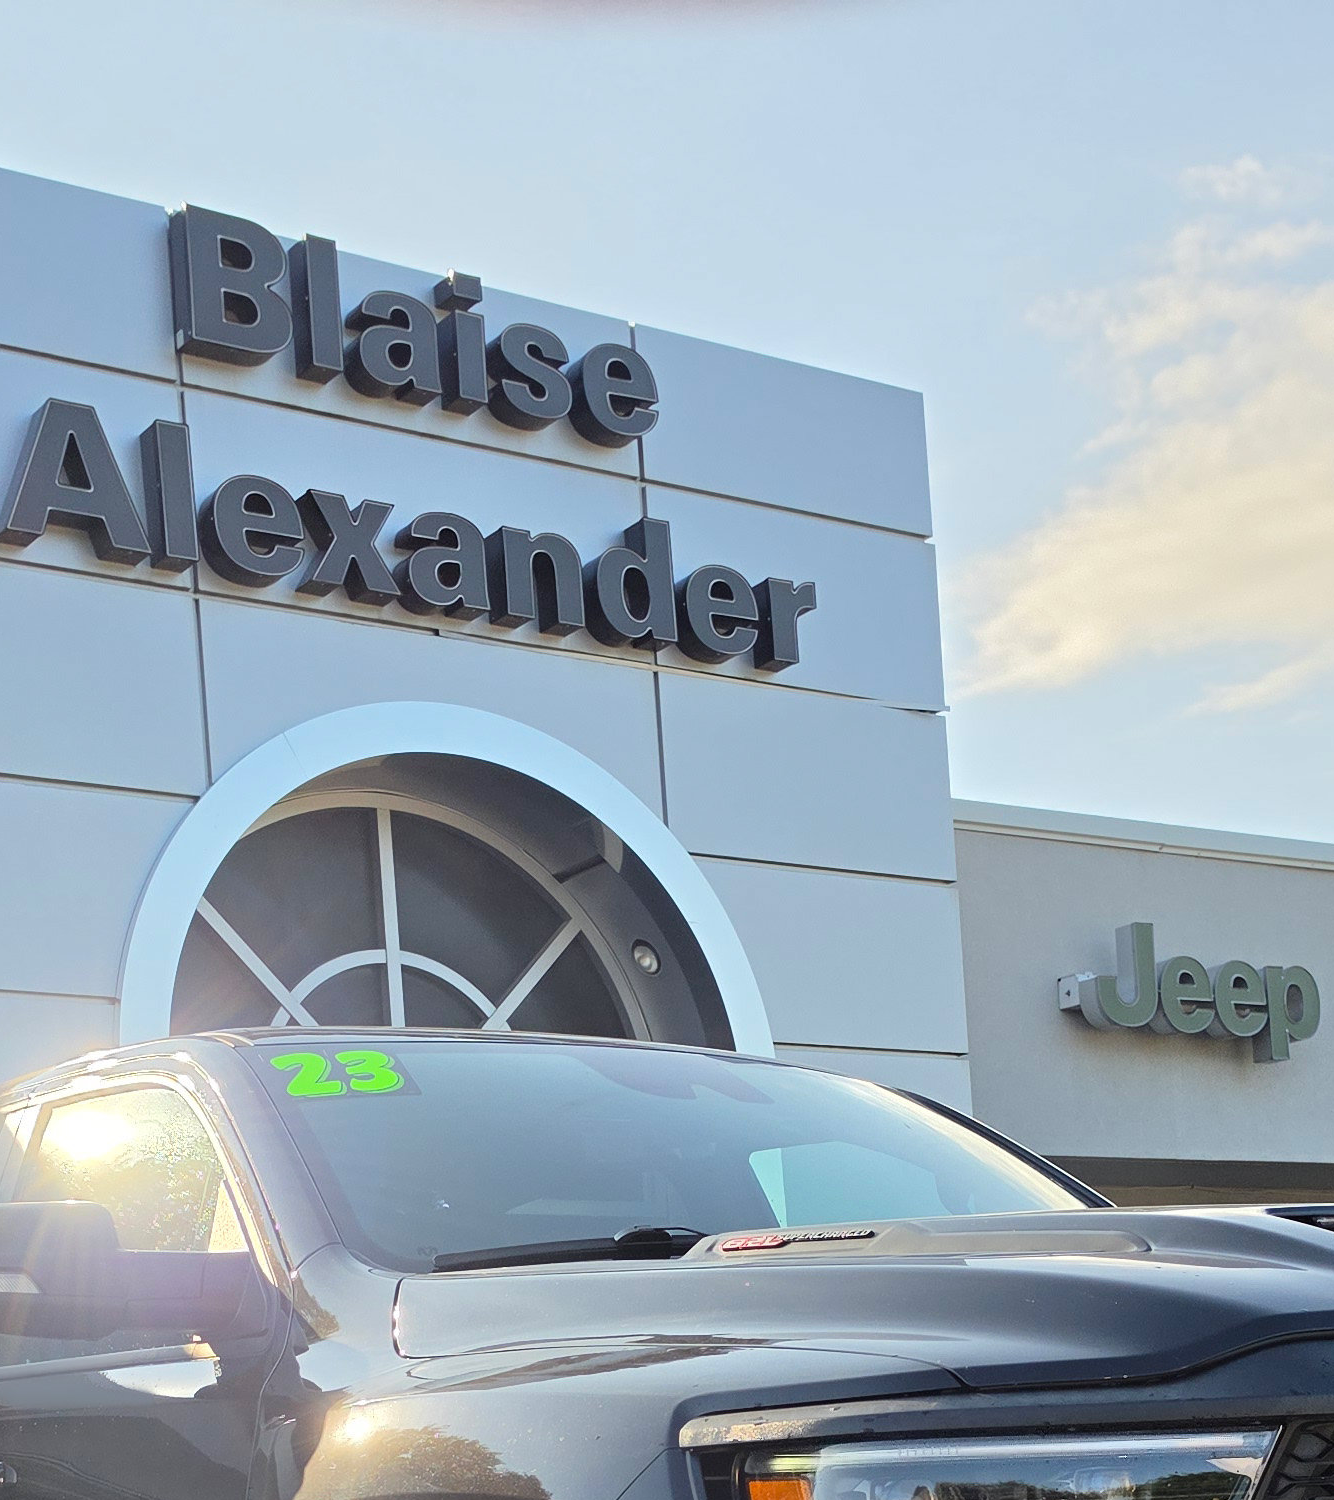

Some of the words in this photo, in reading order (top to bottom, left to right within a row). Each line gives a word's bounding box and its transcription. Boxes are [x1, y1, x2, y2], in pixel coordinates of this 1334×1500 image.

[170, 202, 659, 448] Blaise
[1079, 921, 1321, 1064] Jeep
[270, 1050, 406, 1098] 23
[777, 1228, 873, 1241] SUPERCHARGED
